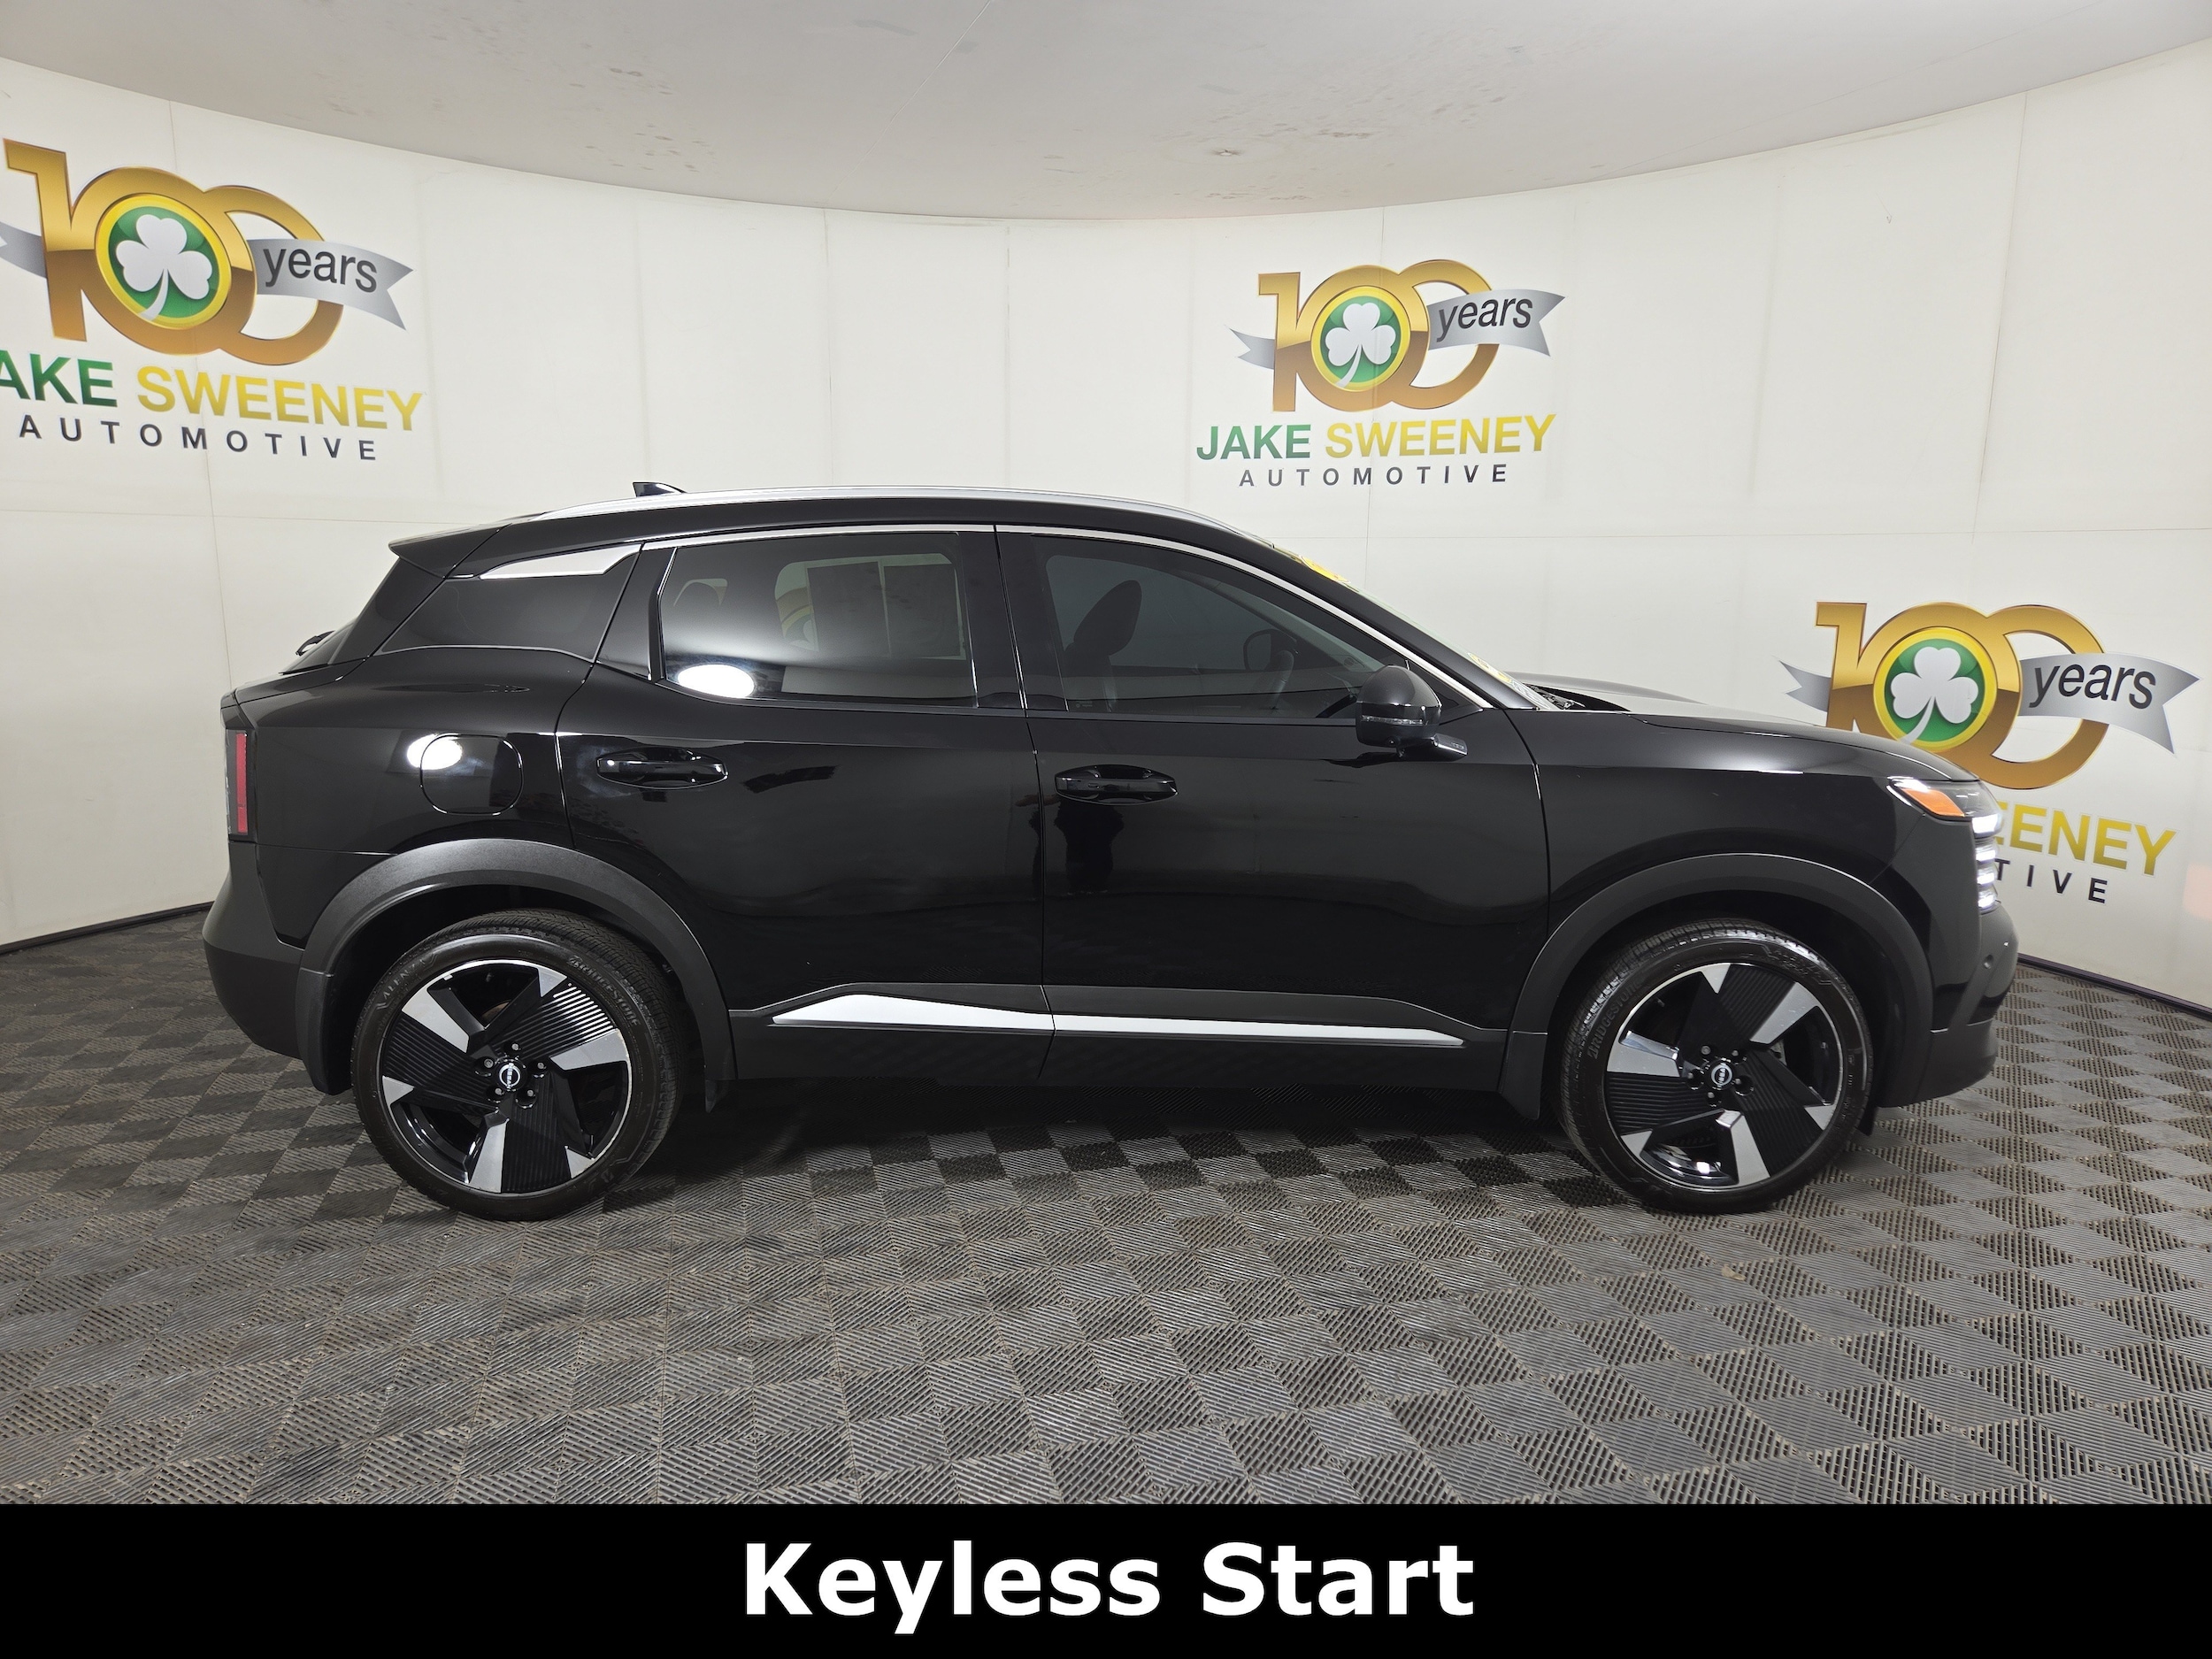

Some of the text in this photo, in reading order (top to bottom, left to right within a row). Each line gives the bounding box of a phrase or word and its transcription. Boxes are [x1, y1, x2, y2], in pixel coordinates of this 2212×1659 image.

[3, 137, 378, 366] 100 years
[1257, 259, 1533, 412] 100 years
[136, 365, 423, 432] SWEENEY
[19, 414, 377, 461] AUTOMOTIVE
[1196, 413, 1557, 460] JAKE SWEENEY
[1239, 464, 1508, 488] AUTOMOTIVE
[1815, 601, 2157, 790] 100 years
[1994, 800, 2177, 877] ENEY
[565, 954, 642, 1027] BRIDGESTONE
